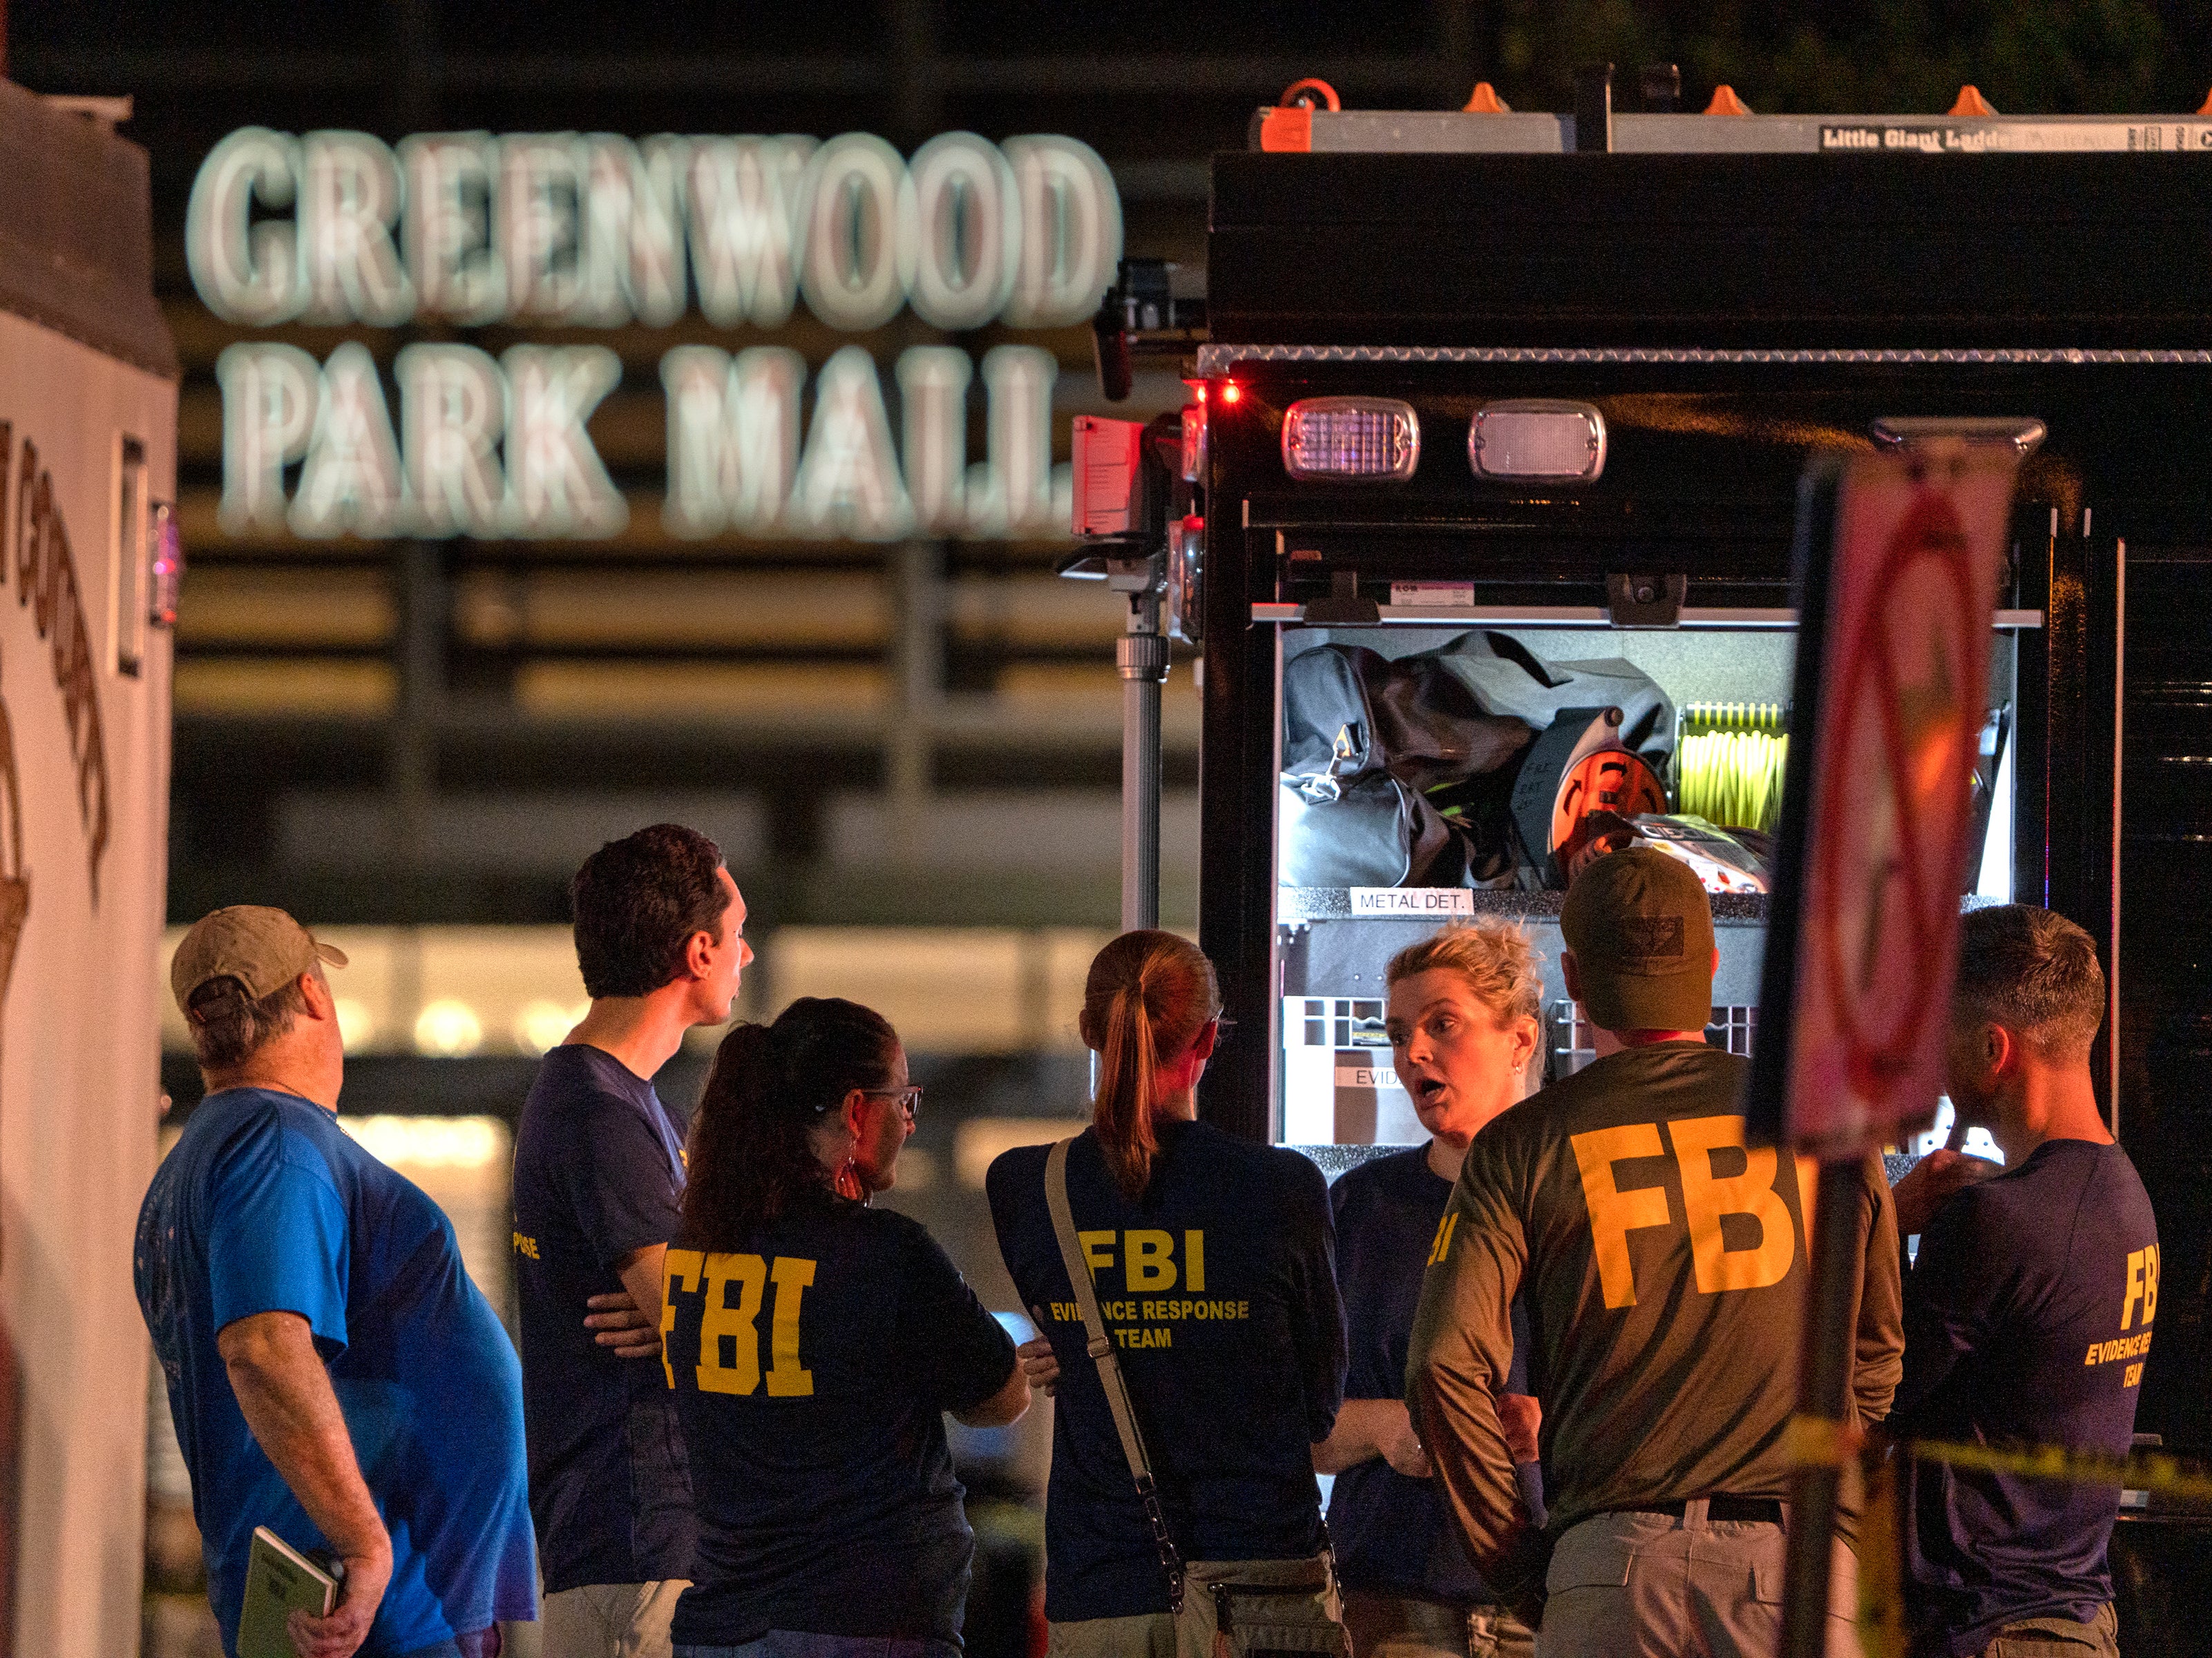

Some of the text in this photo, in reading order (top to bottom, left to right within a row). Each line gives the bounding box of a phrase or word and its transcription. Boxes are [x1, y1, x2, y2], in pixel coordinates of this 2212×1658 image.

[1824, 129, 1879, 148] Little
[1885, 129, 1939, 151] Giant
[185, 126, 1122, 330] GREENWOOD
[216, 341, 1073, 543] PARK MALL
[1360, 894, 1465, 909] METAL DET.
[1570, 1114, 1820, 1310] FB
[1076, 1229, 1205, 1293] FBI
[659, 1248, 817, 1397] FBI
[1050, 1301, 1249, 1321] EVINCE RESPONSE
[1114, 1328, 1172, 1349] TEAM
[2084, 1334, 2142, 1366] EVIDENCE
